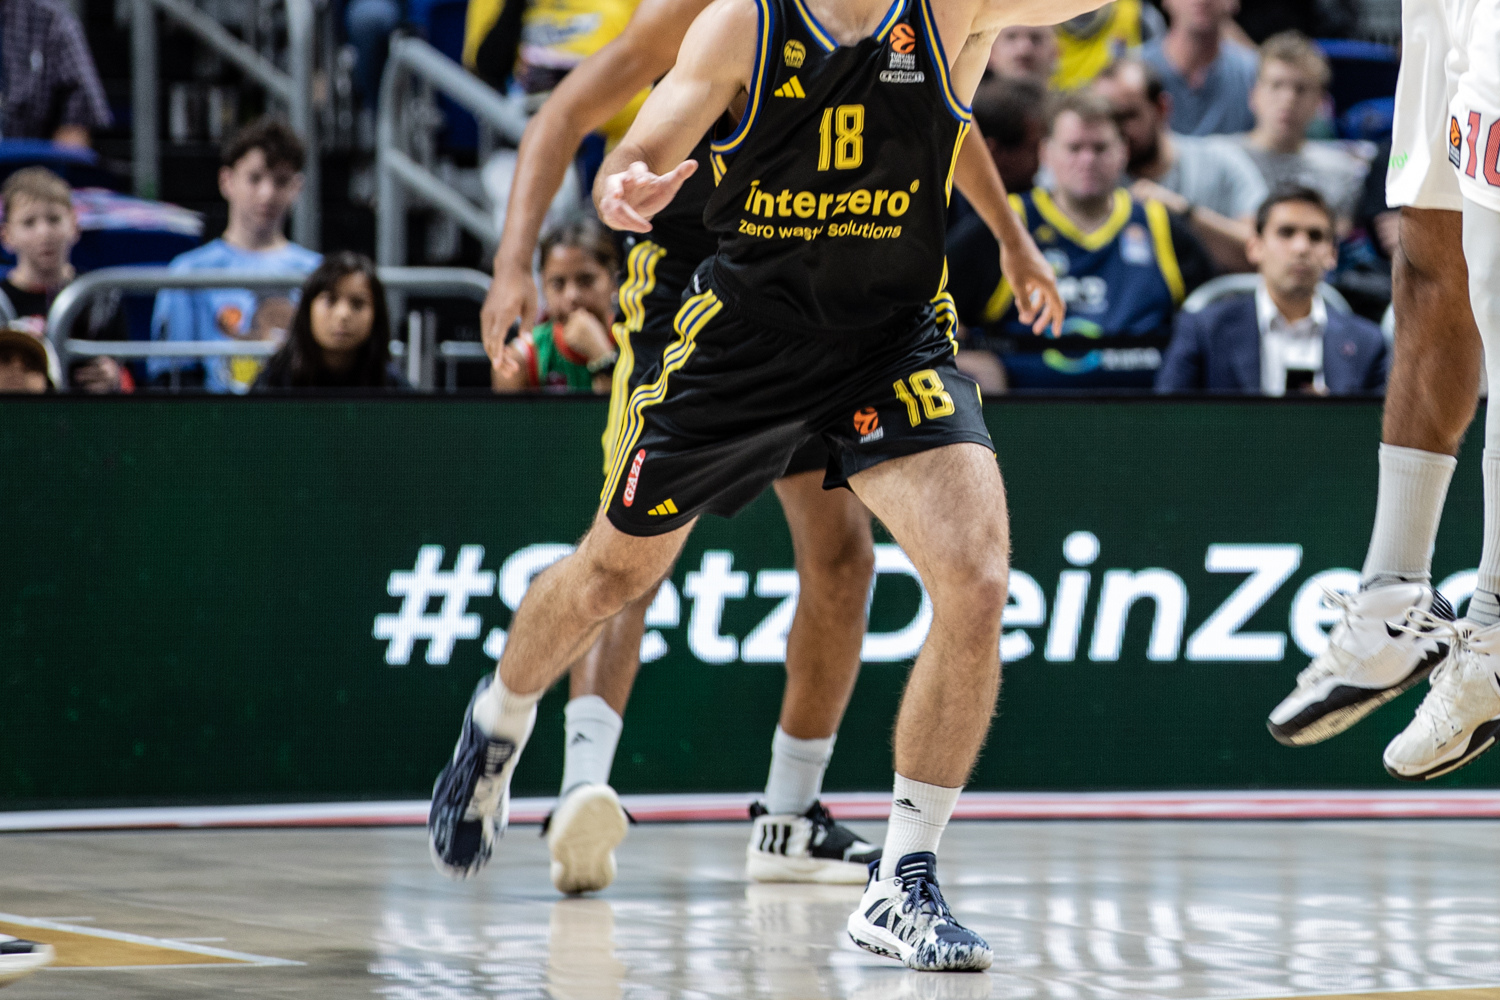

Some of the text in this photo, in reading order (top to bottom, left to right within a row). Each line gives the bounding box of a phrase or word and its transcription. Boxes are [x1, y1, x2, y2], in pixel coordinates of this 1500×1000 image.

[817, 104, 865, 172] 18
[738, 219, 903, 242] zero wast solutions
[893, 369, 956, 428] 18
